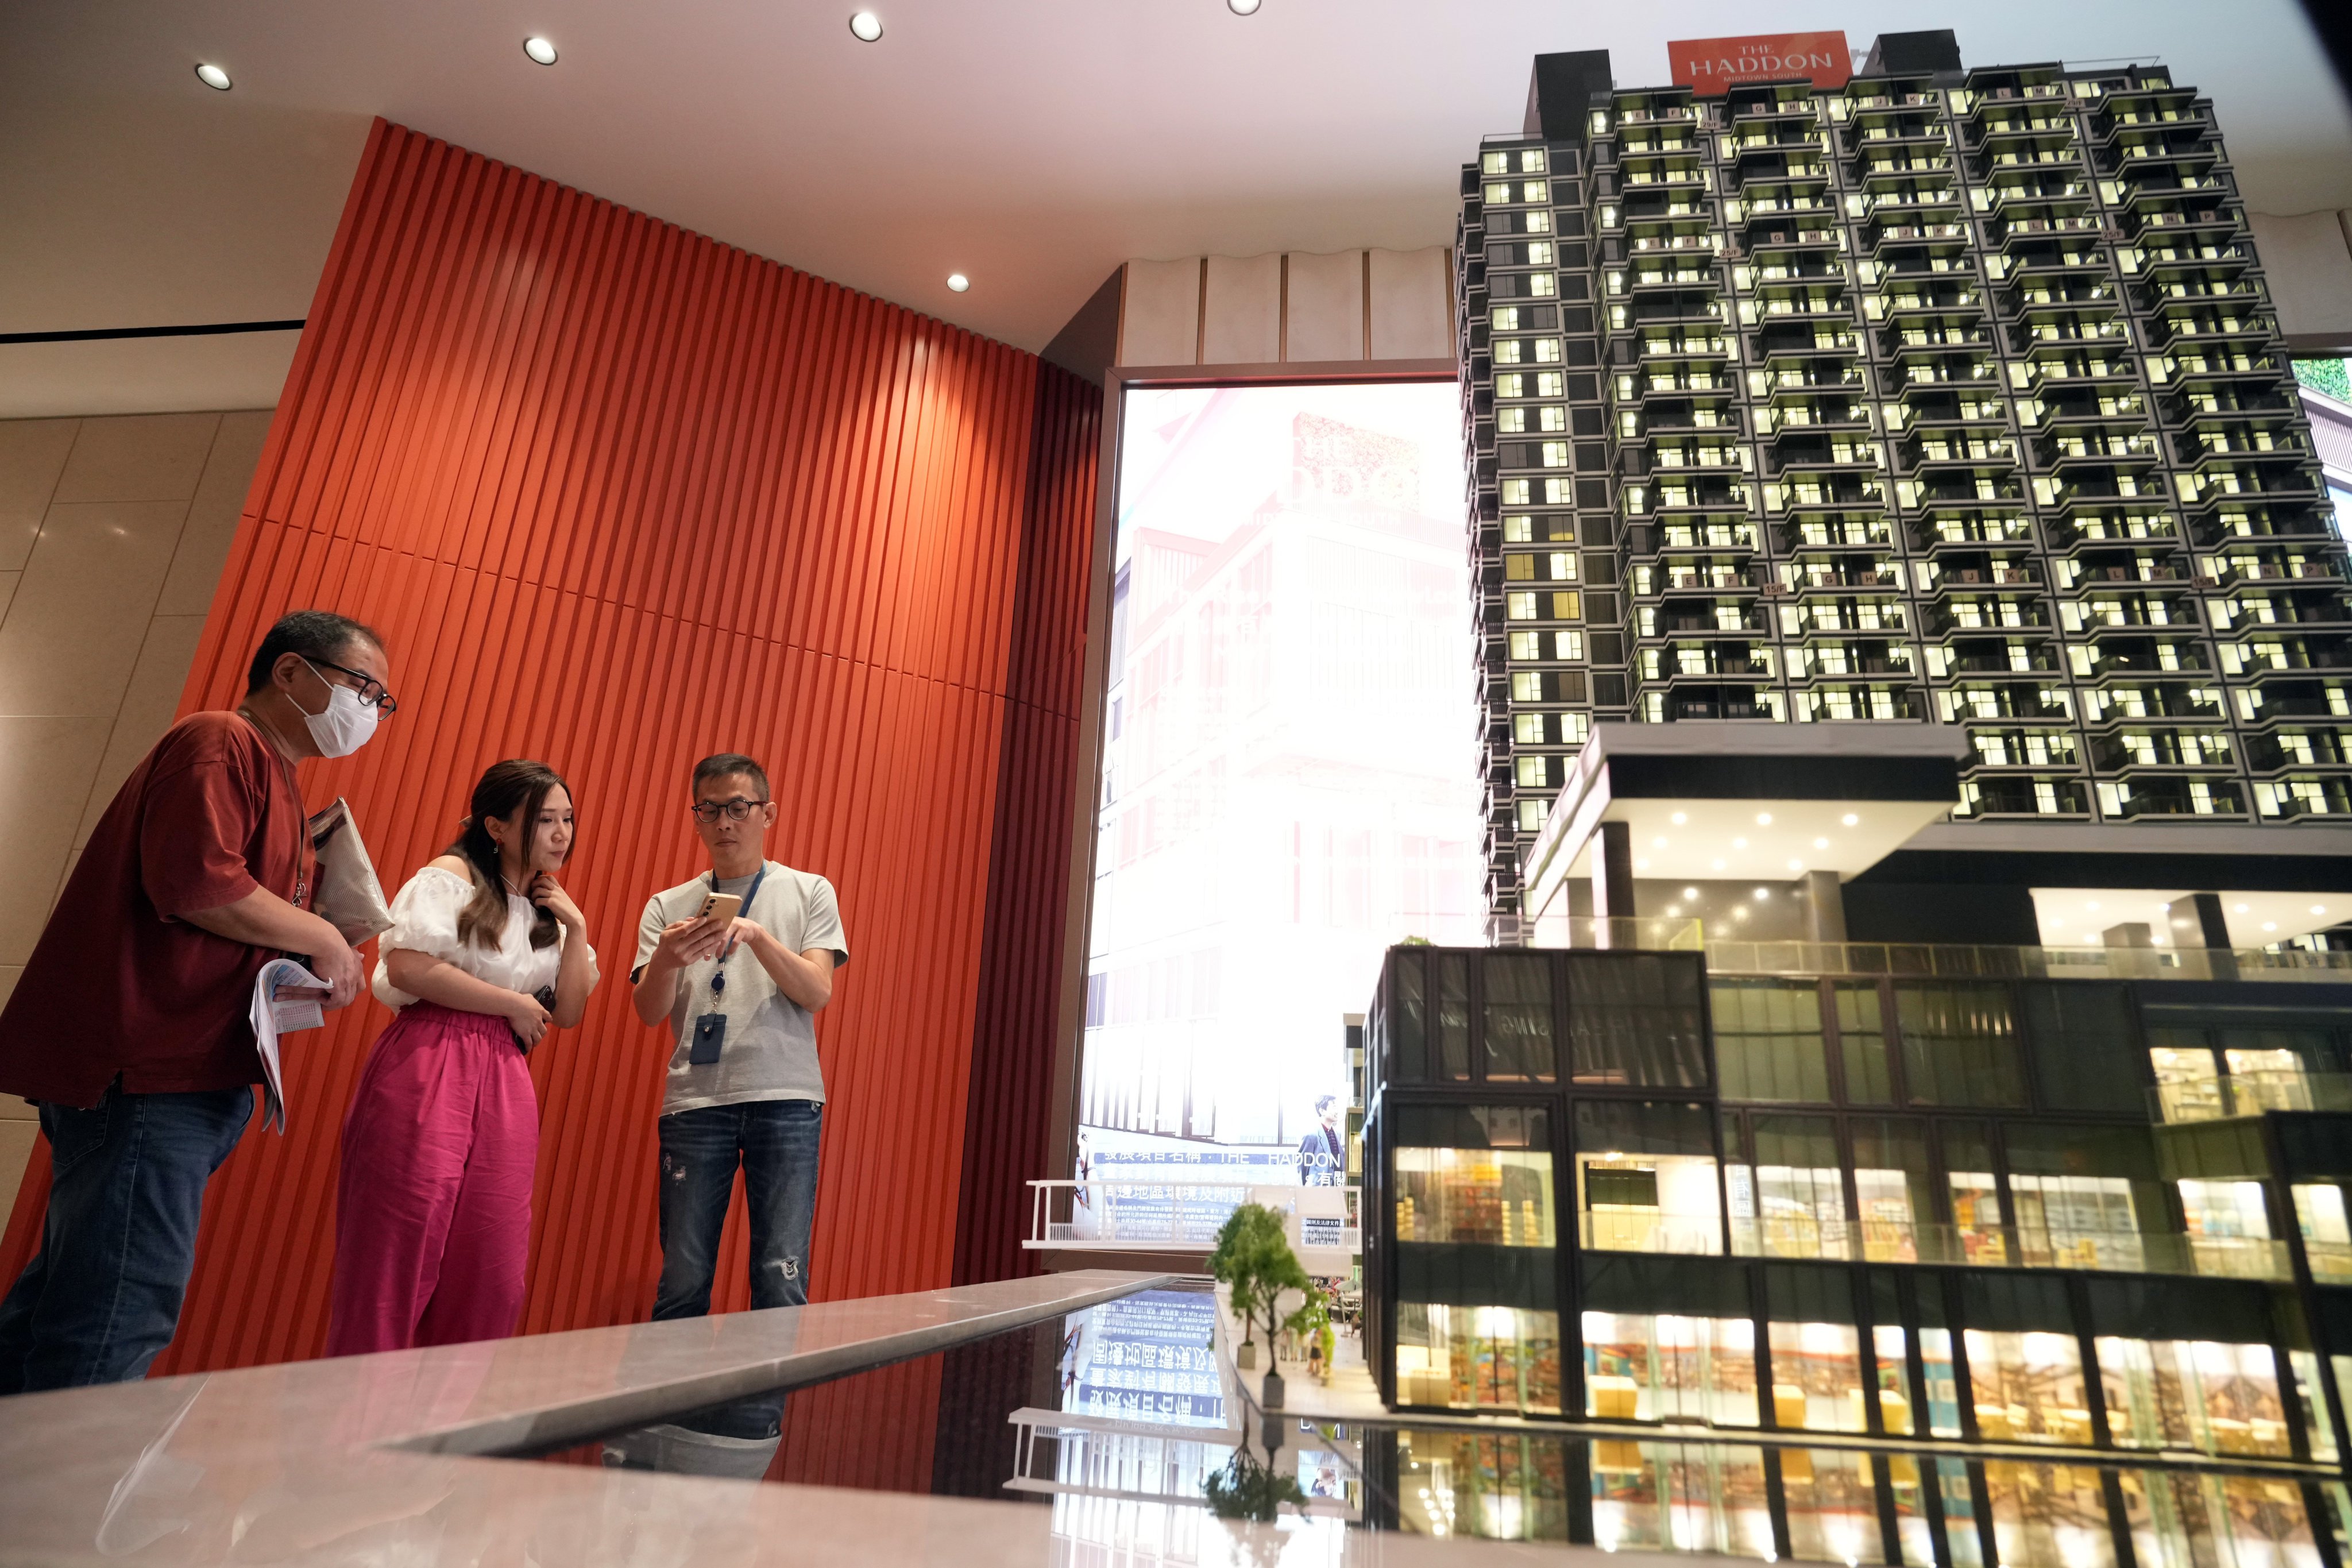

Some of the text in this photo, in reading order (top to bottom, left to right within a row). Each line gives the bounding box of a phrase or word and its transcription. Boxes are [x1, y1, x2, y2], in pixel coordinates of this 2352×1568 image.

[1739, 44, 1774, 55] THE
[1690, 52, 1832, 76] HADDON
[1724, 72, 1802, 83] MIDTOWN SOUTH
[1825, 575, 1832, 583] G
[1766, 585, 1785, 593] 15/F
[1268, 1152, 1341, 1168] HADDON
